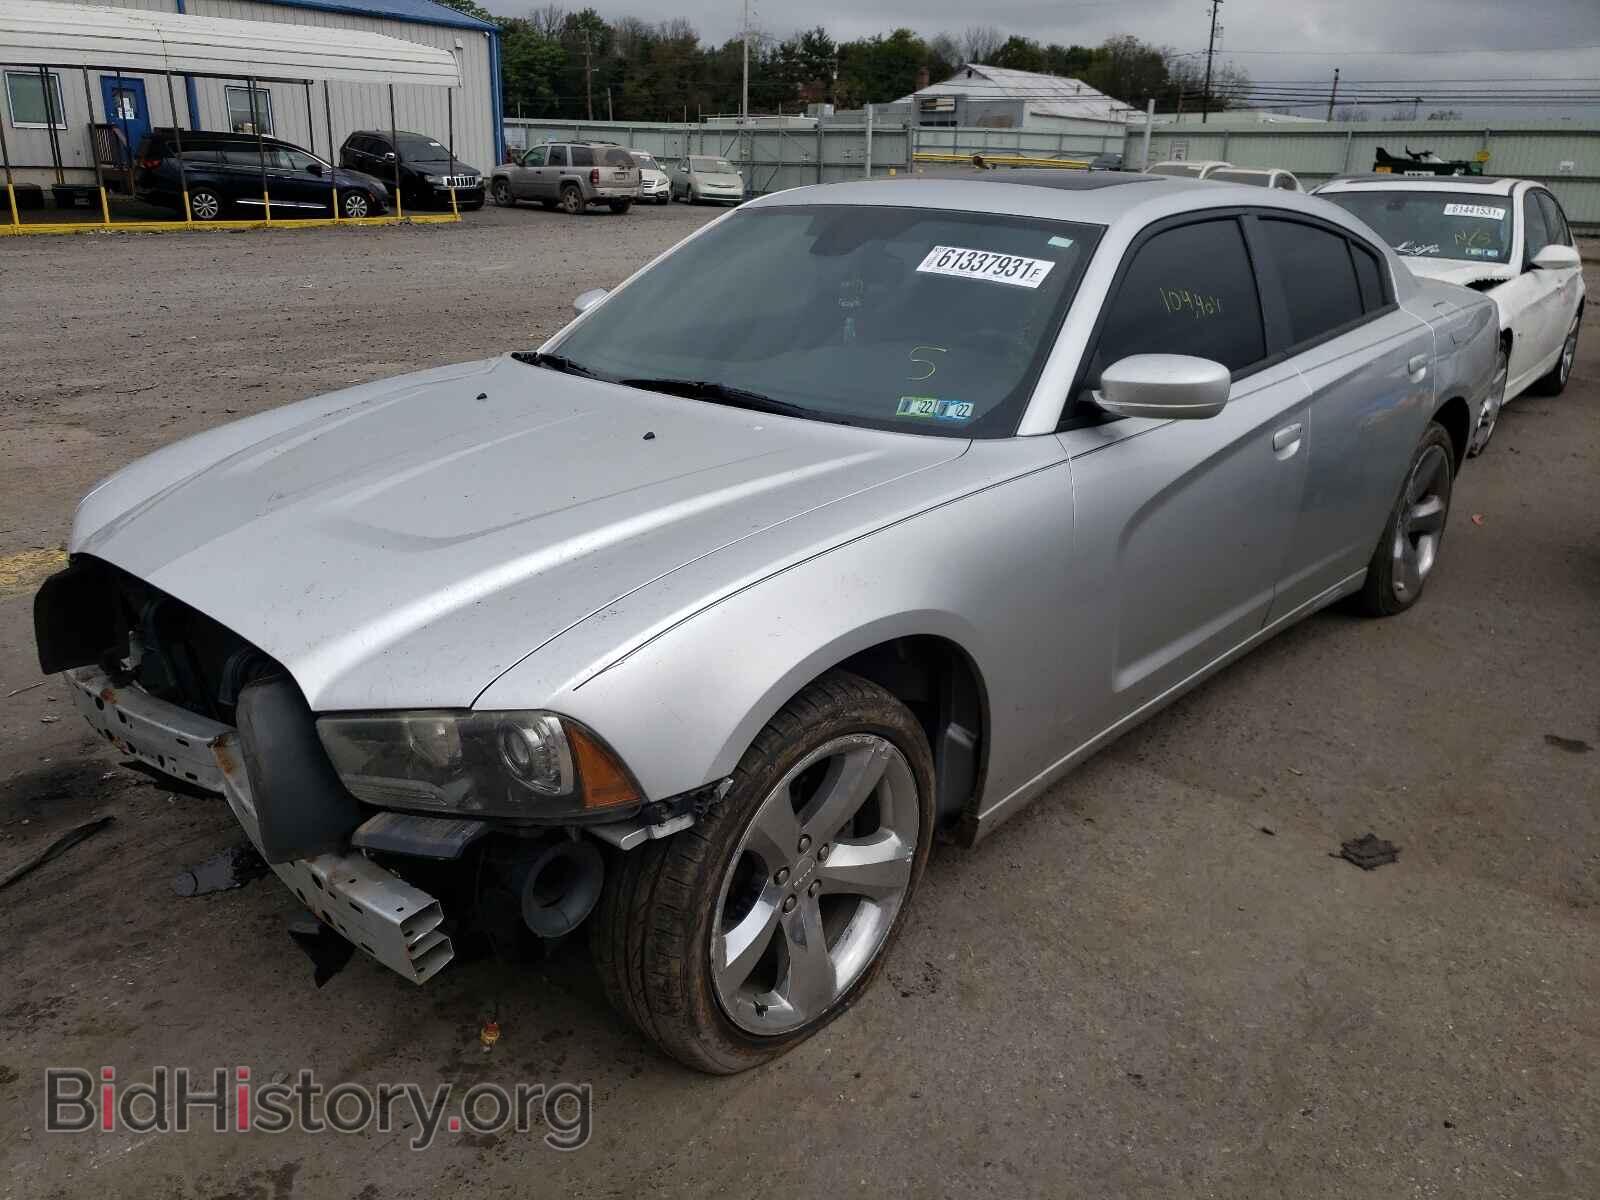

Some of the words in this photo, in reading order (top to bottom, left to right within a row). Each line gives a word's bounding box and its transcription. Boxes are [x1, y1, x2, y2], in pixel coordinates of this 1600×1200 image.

[936, 249, 1034, 280] 61337931
[920, 400, 933, 414] 22
[956, 404, 970, 418] 22
